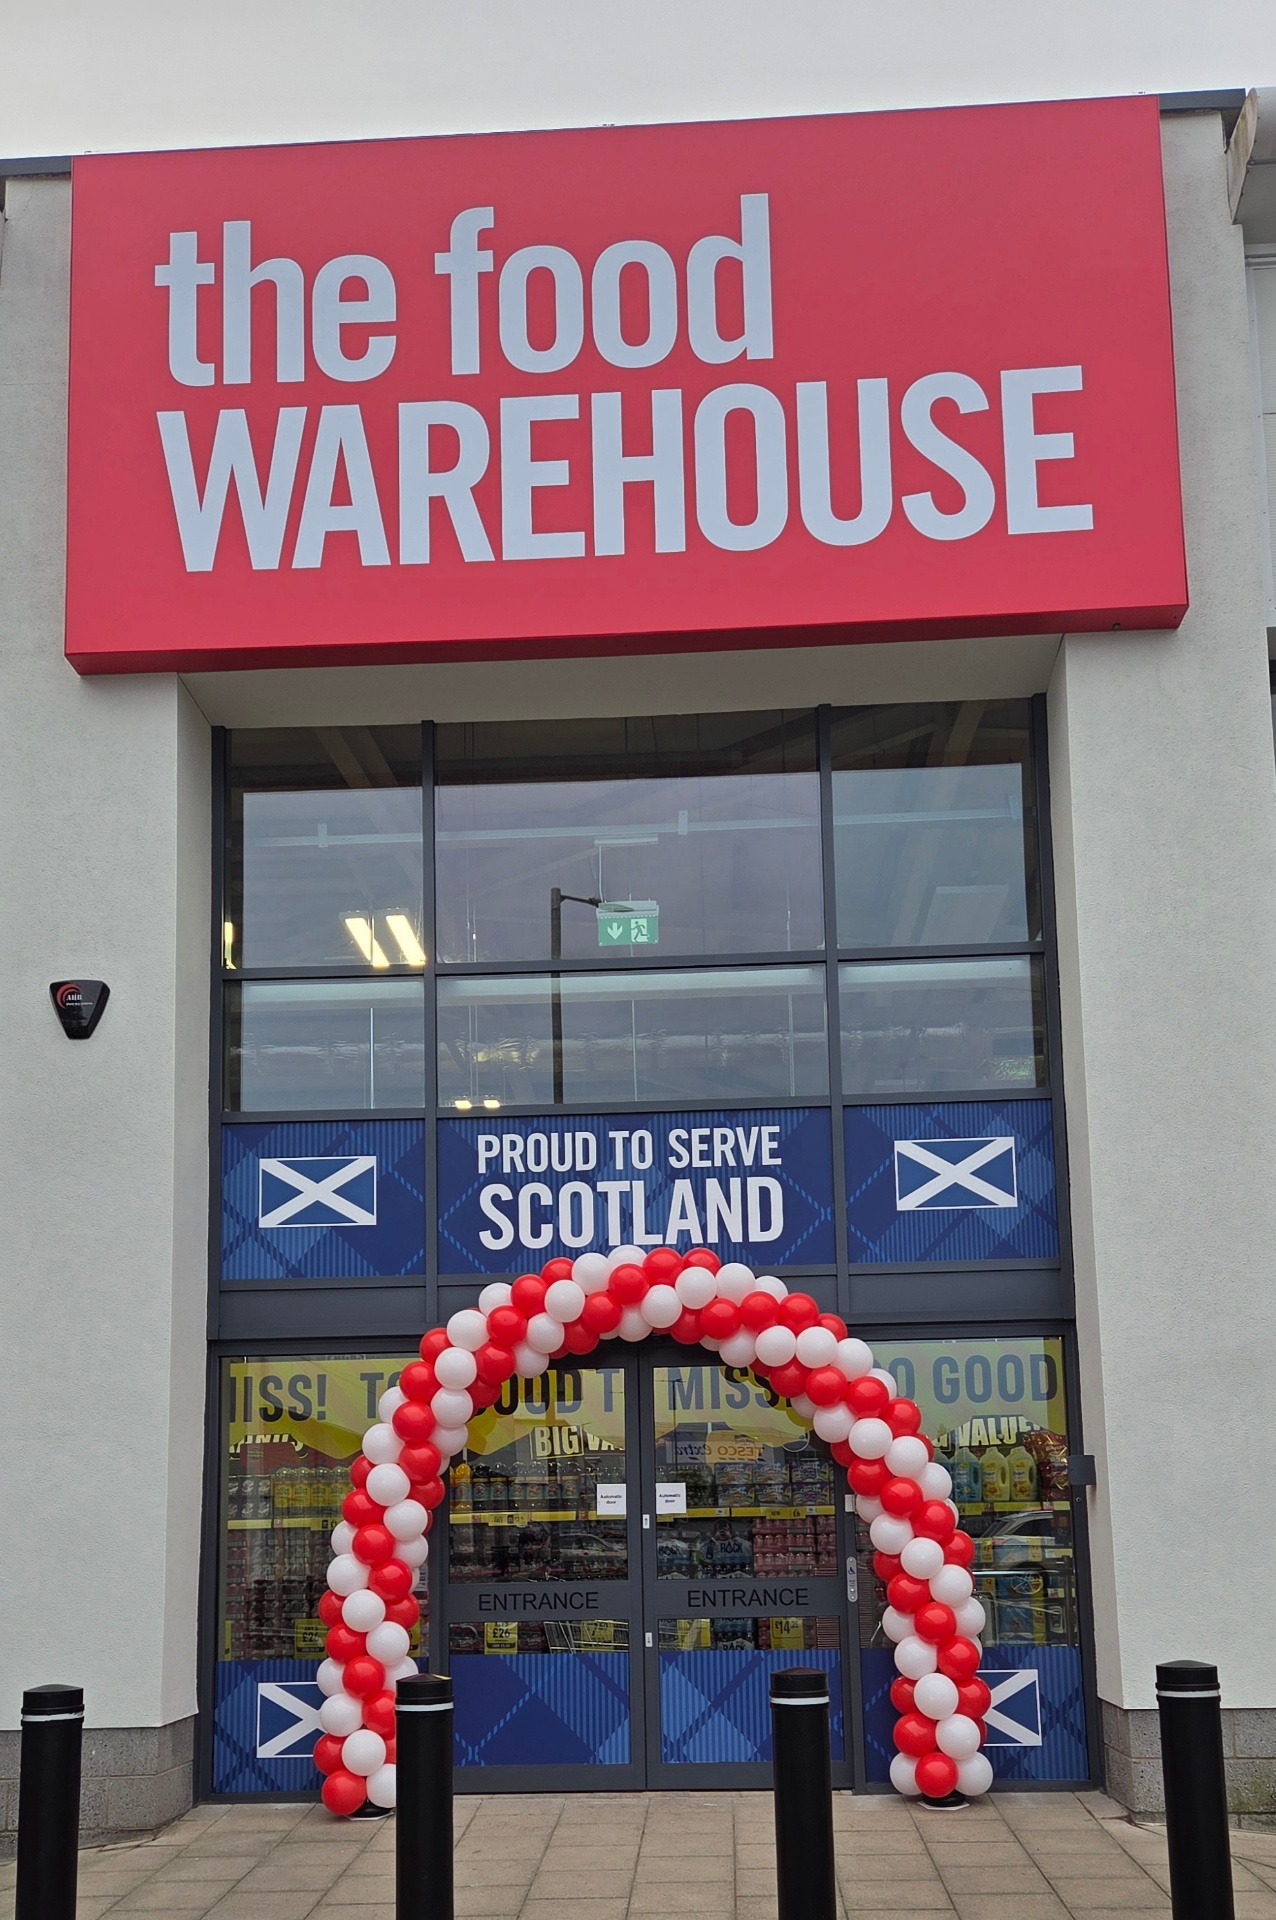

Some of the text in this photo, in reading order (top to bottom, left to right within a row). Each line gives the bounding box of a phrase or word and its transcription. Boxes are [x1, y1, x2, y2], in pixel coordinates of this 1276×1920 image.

[154, 193, 774, 387] the food
[156, 365, 1094, 573] WAREHOUSE
[478, 1125, 782, 1174] PROUD TO SERVE
[479, 1176, 784, 1250] SCOTLAND
[932, 1353, 1058, 1404] GOOD
[534, 1425, 580, 1458] BIG
[478, 1592, 599, 1611] ENTRANCE
[687, 1588, 809, 1607] ENTRANCE
[492, 1627, 511, 1639] £26
